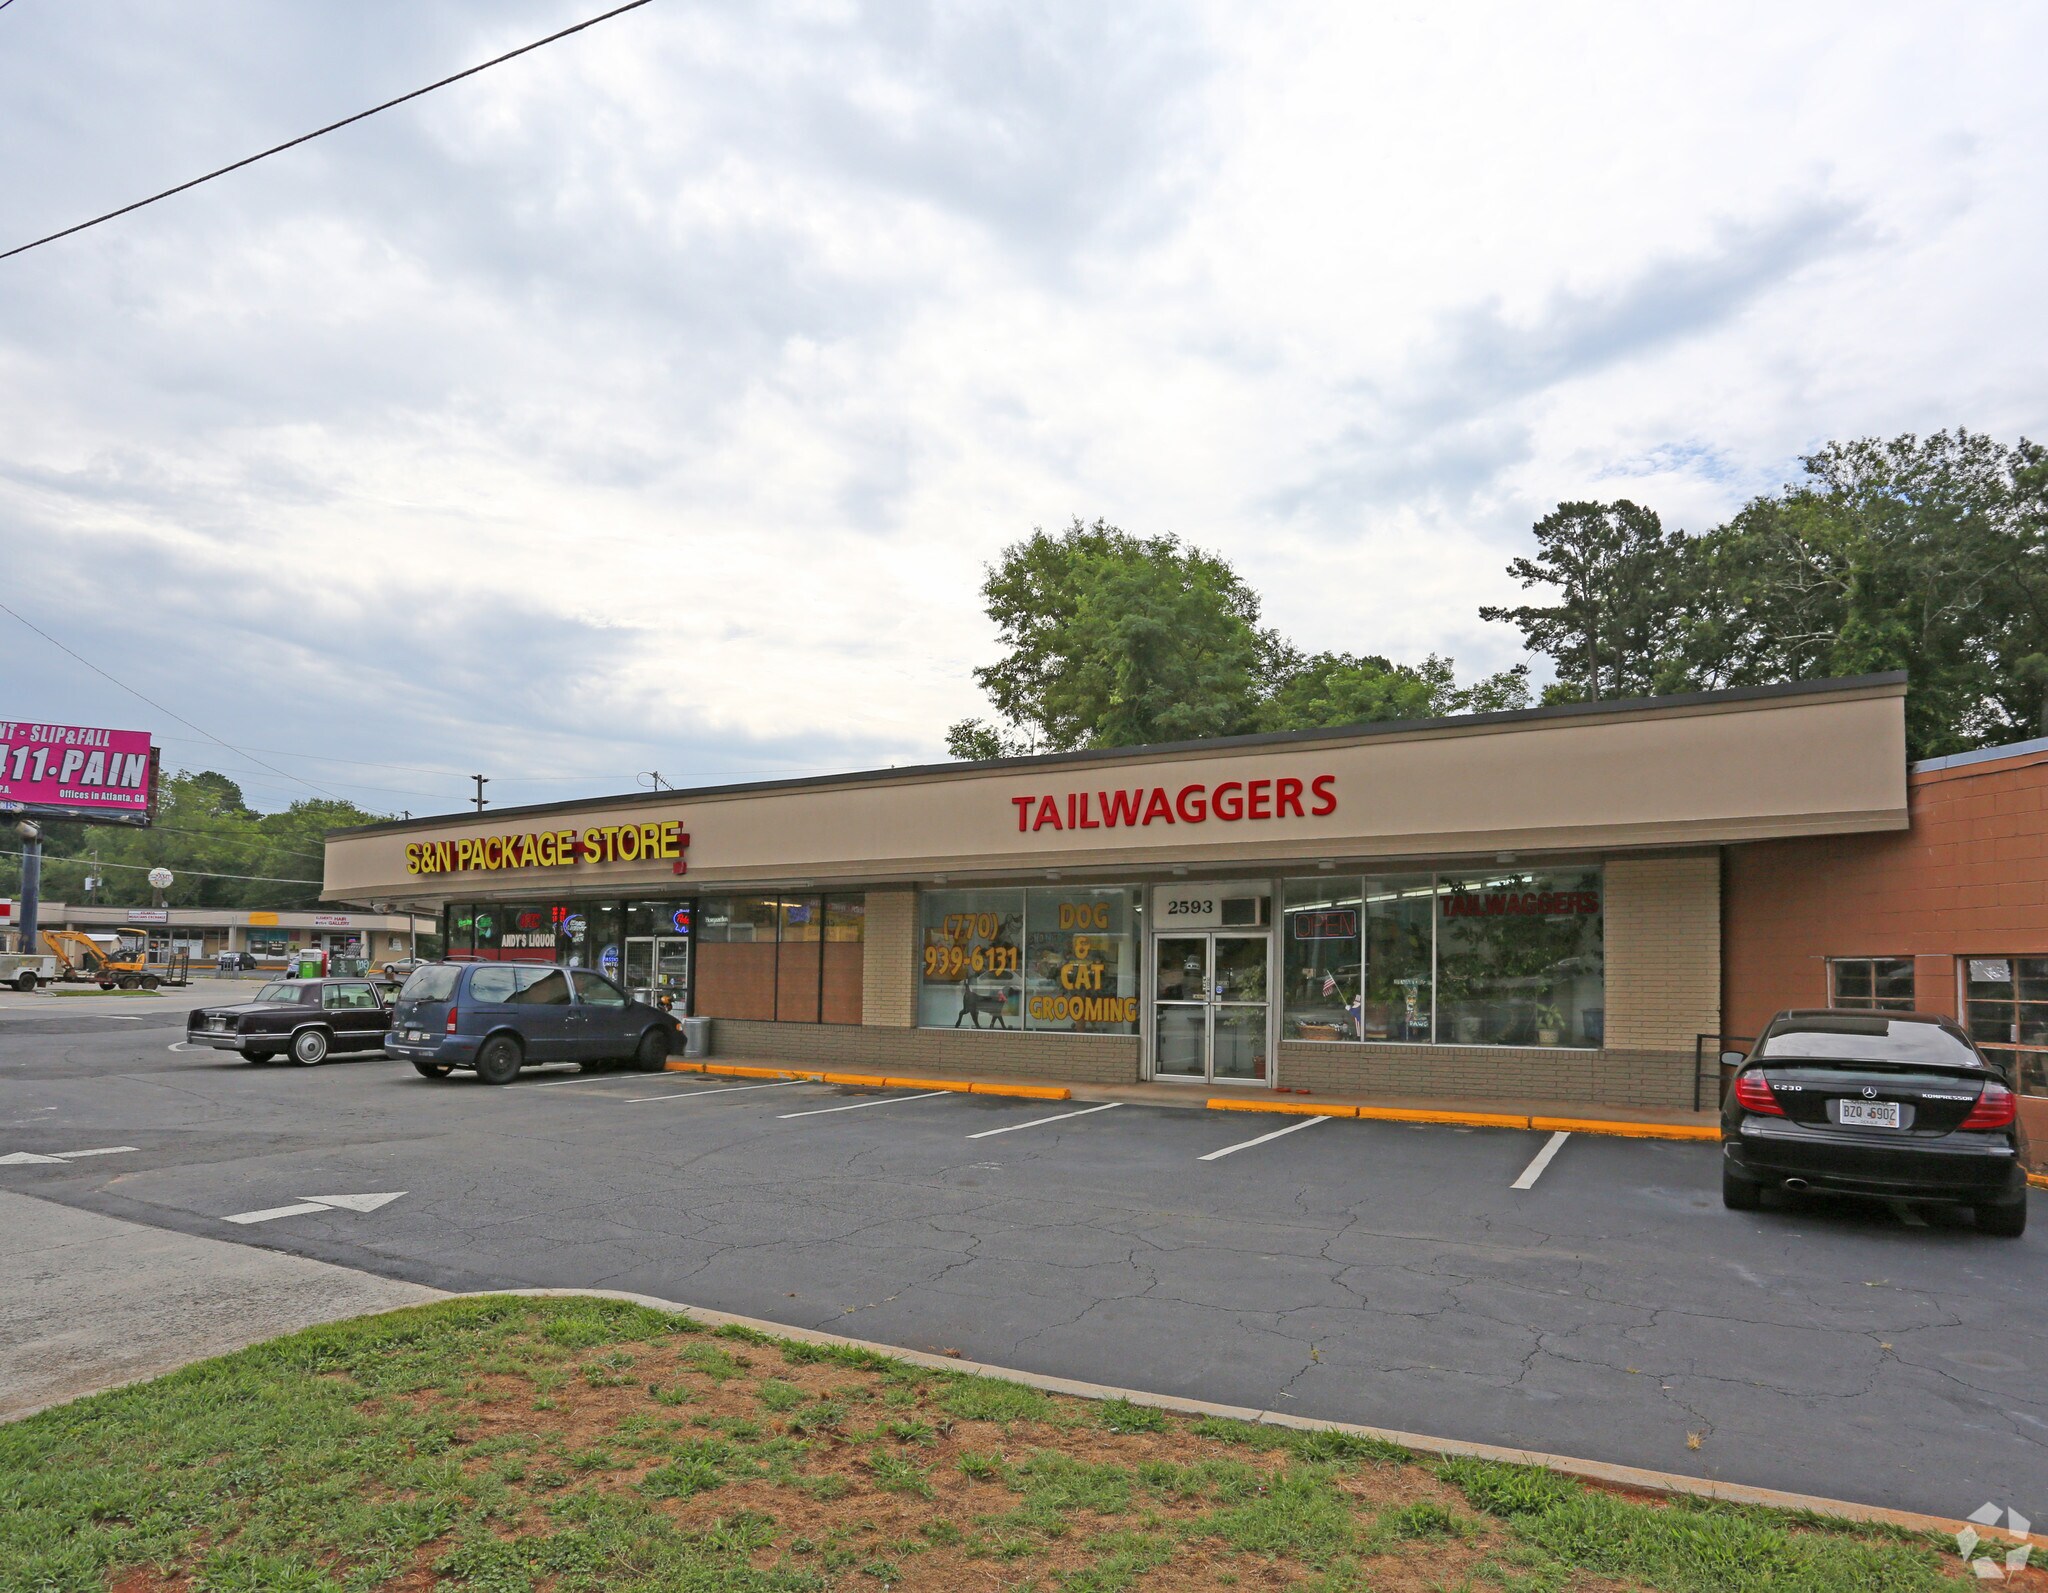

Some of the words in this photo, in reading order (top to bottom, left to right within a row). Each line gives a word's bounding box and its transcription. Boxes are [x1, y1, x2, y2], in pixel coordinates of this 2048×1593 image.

[30, 725, 110, 747] SLIP&FALL
[59, 789, 89, 800] Offices
[91, 791, 100, 800] in
[101, 792, 133, 803] Atlanta,
[134, 795, 145, 803] GA
[1012, 775, 1337, 832] TAILWAGGERS
[405, 840, 452, 875] S&N
[458, 830, 575, 871] PACKAGE
[583, 821, 682, 864] STORE
[1058, 902, 1111, 930] DOG
[1168, 900, 1214, 915] 2593
[1439, 891, 1599, 917] TAILWAGGERS
[943, 912, 999, 941] (770)
[1296, 913, 1355, 937] OPEN
[501, 934, 527, 948] ANDY'S
[528, 933, 556, 947] LIQUOR
[1074, 935, 1091, 960] &
[925, 945, 1018, 976] 939-6131
[1060, 964, 1105, 990] CAT
[1029, 995, 1137, 1023] GROOMING
[1922, 1093, 1973, 1101] KOMPRESSOR
[1843, 1105, 1862, 1118] BZQ
